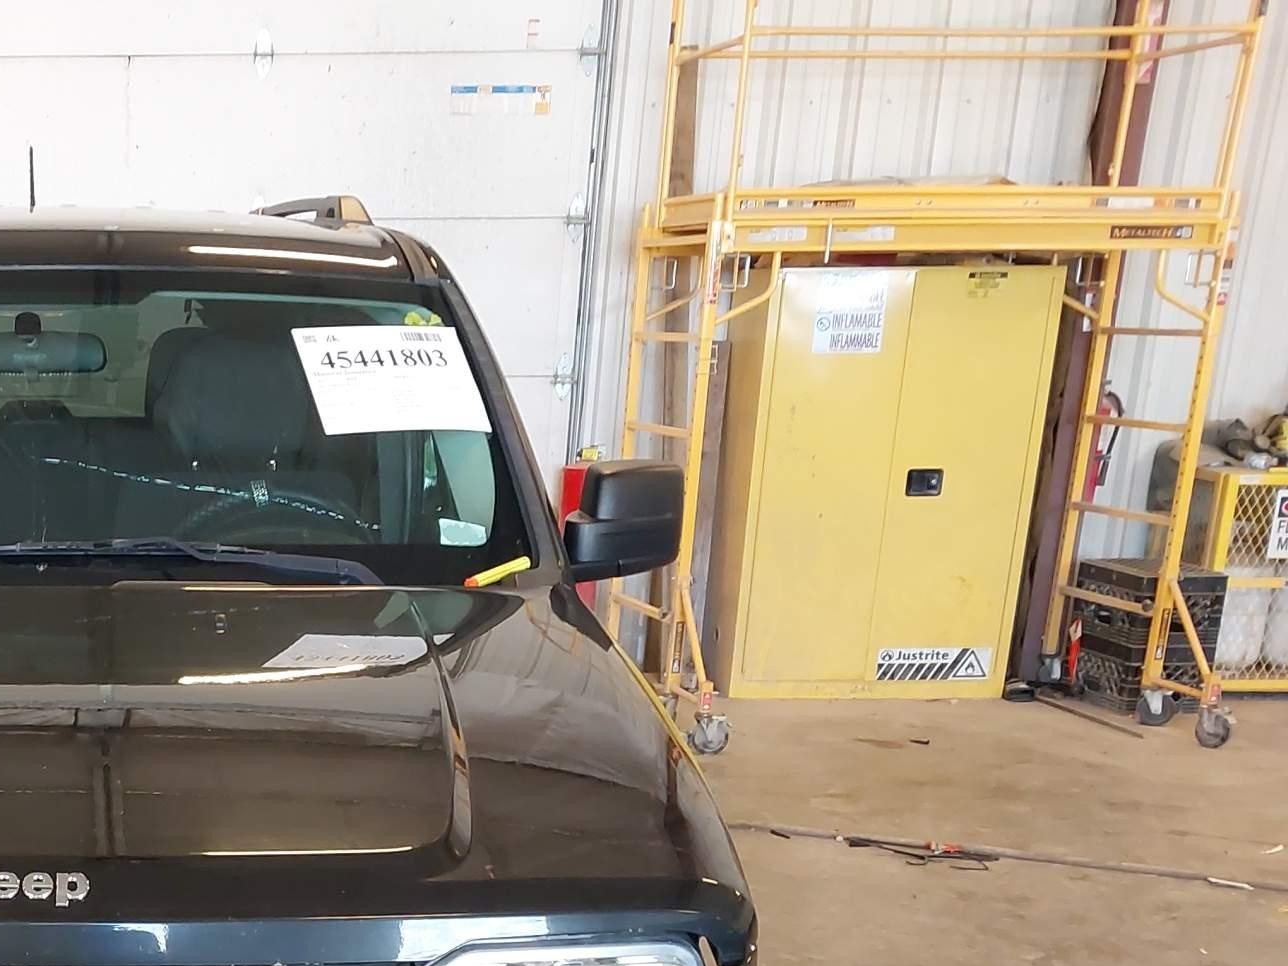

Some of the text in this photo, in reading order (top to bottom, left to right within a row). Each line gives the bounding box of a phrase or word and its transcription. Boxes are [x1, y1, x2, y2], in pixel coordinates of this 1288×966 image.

[831, 312, 882, 329] INFLAMABLE
[829, 332, 881, 349] INFLAMMABLE
[320, 349, 448, 369] 45441803
[895, 649, 949, 661] Justrite
